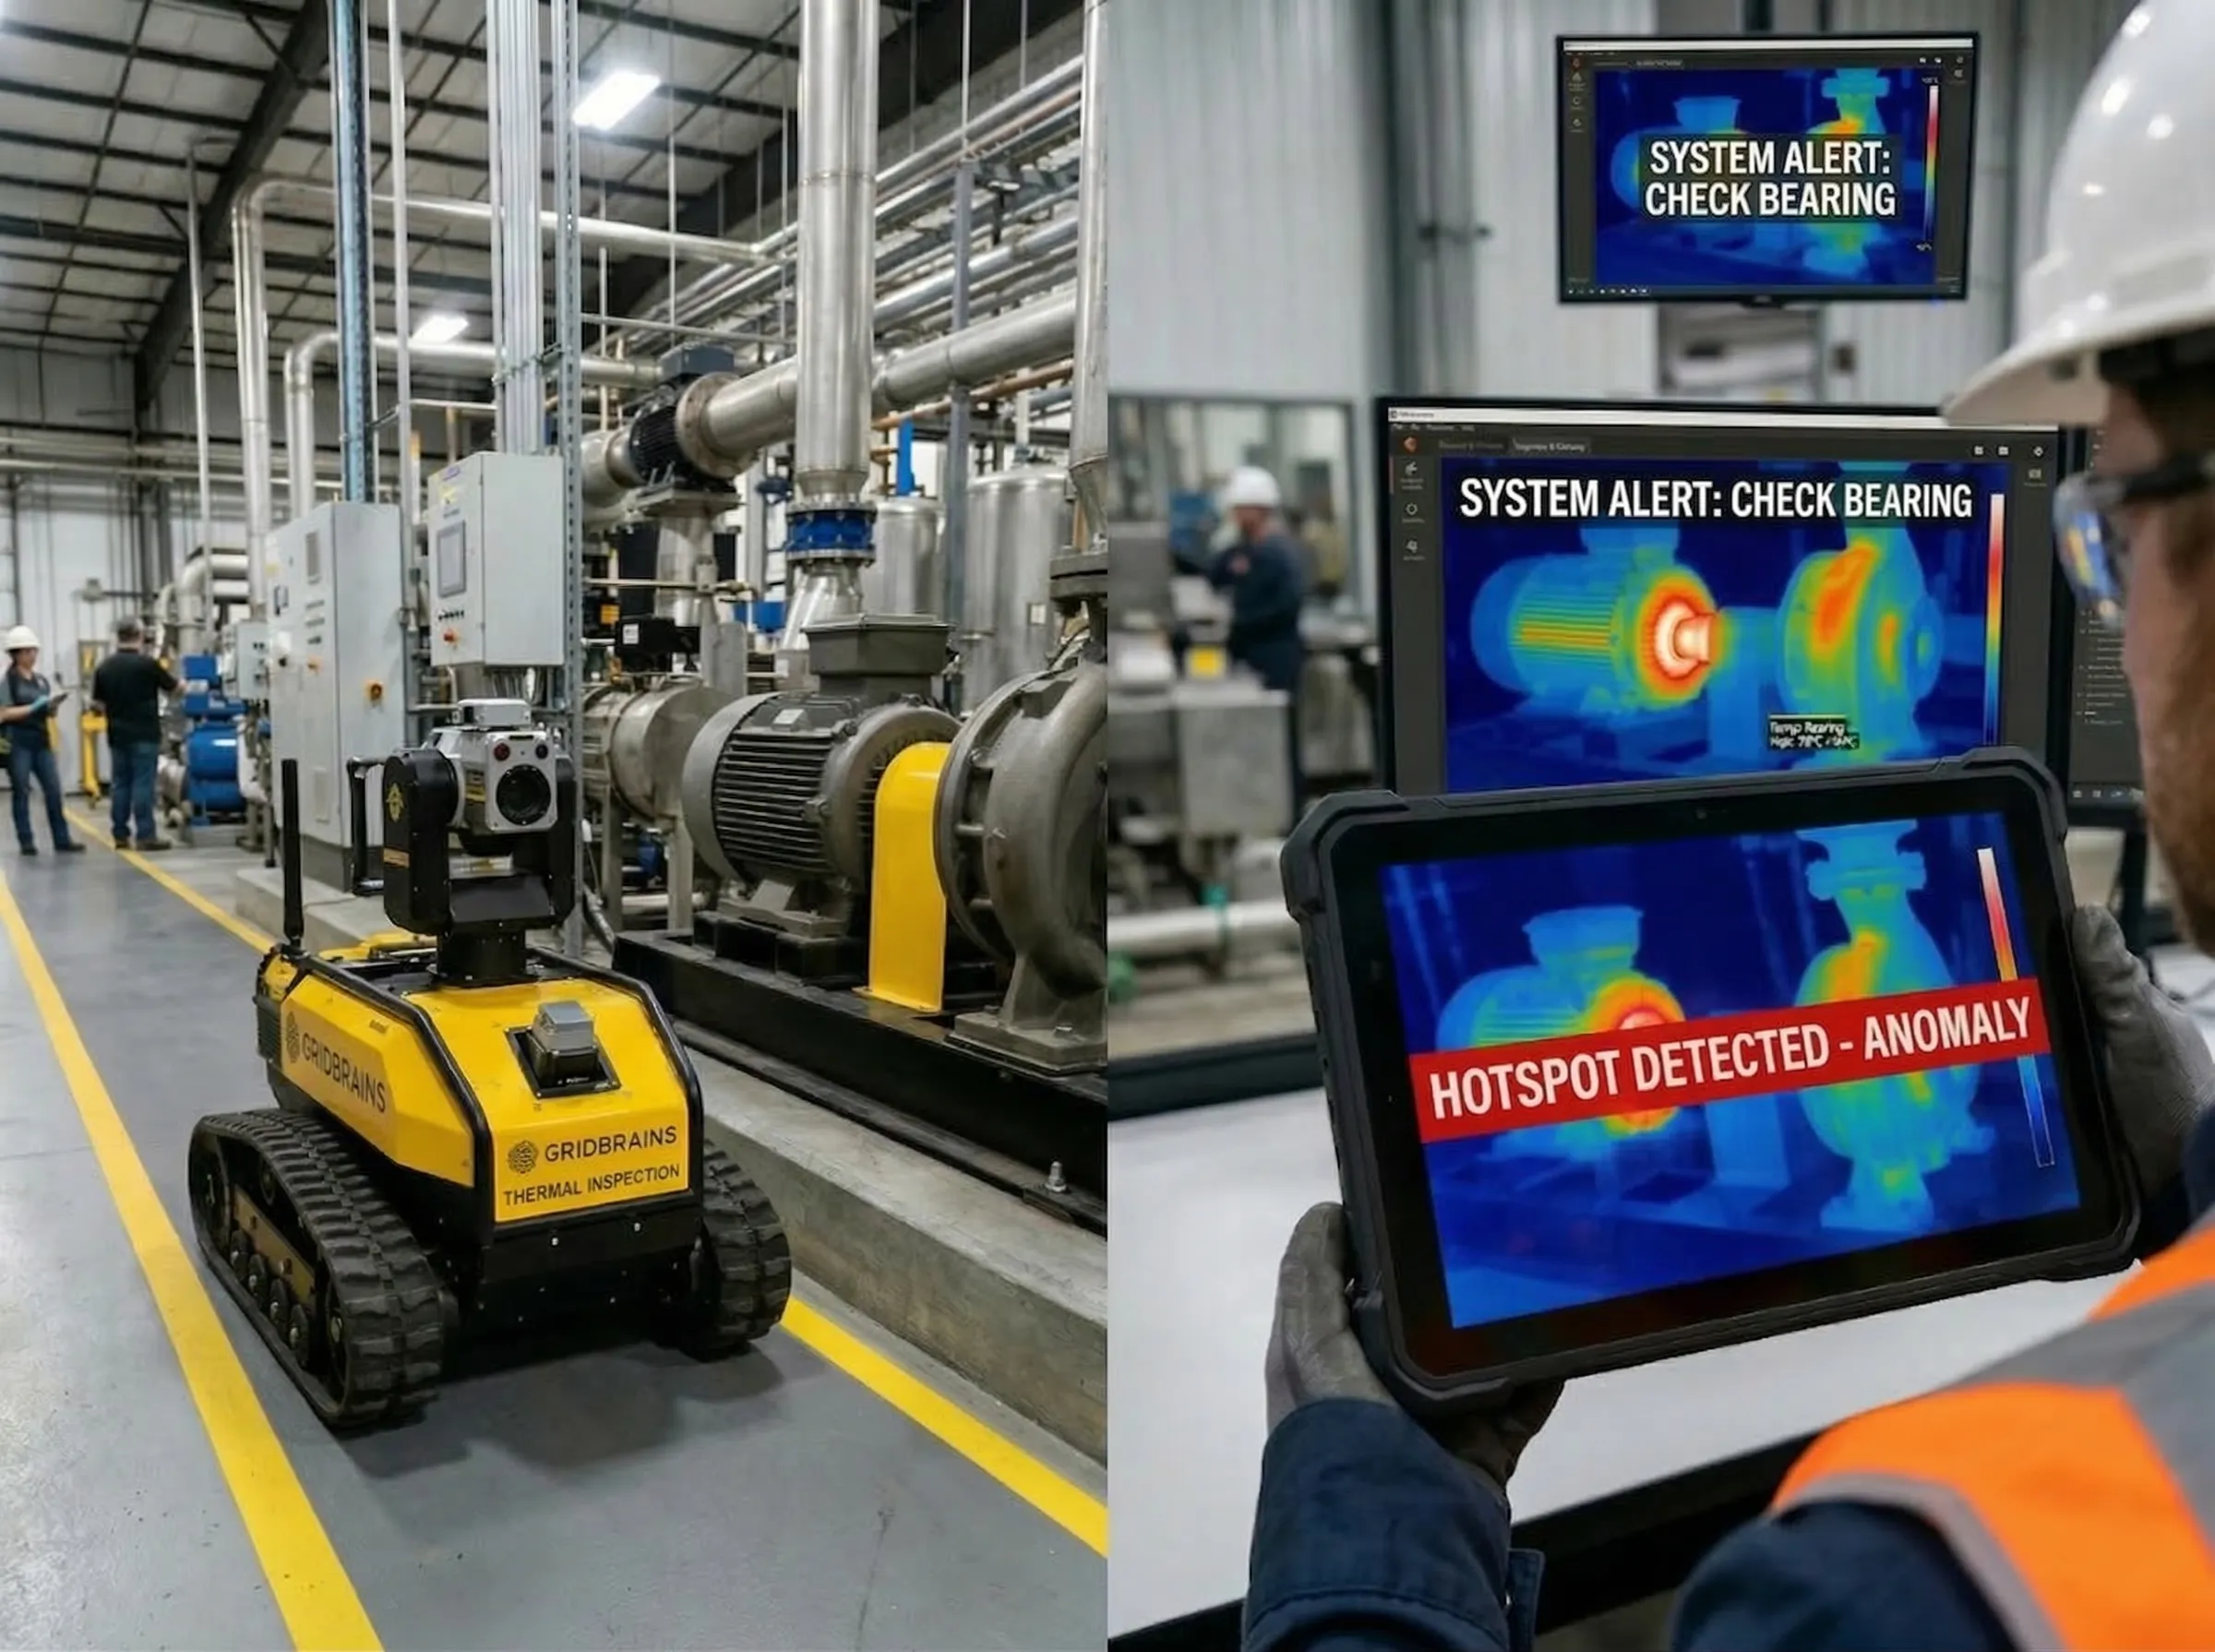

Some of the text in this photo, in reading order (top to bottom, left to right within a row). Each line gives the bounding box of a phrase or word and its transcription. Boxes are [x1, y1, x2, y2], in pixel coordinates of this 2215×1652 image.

[1650, 140, 1891, 174] SYSTEM ALERT:
[1645, 182, 1896, 217] CHECK BEARING
[1460, 478, 1972, 518] SYSTEM ALERT: CHECK BEARING
[302, 1032, 387, 1113] GRIDBRAINS
[1430, 1050, 1621, 1119] HOTSPOT
[1632, 1024, 1830, 1092] DETECTED
[1863, 997, 2032, 1059] ANOMALY
[545, 1126, 677, 1162] GRIDBRAINS
[504, 1164, 679, 1206] THERMAL INSPECTION
